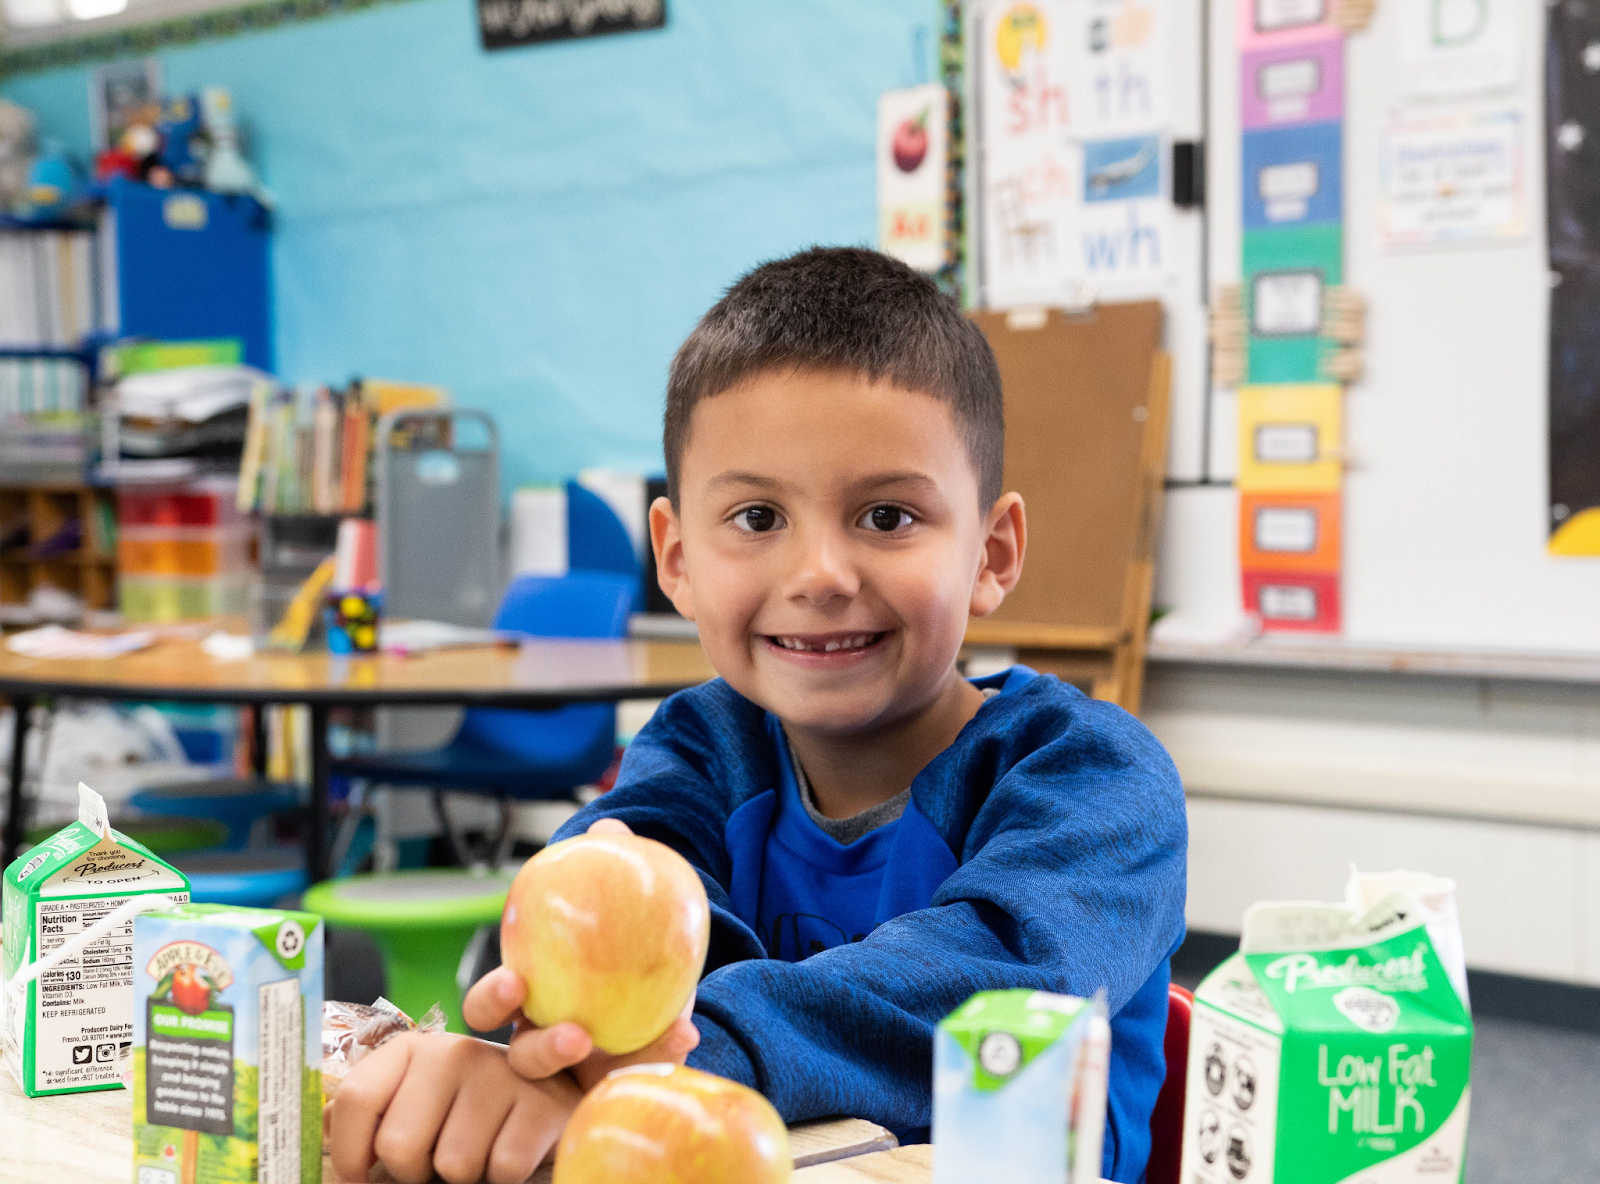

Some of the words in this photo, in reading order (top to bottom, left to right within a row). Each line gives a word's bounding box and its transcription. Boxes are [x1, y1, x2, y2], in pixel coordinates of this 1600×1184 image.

[1007, 65, 1070, 136] sh
[1094, 60, 1150, 118] th
[1081, 203, 1161, 271] wh
[74, 860, 145, 877] Producers
[41, 904, 59, 912] GRADE
[70, 901, 105, 910] PASTEURIZED
[42, 915, 76, 924] Nutrition
[42, 925, 64, 934] Facts
[156, 946, 191, 971] APPLE
[42, 970, 64, 978] Calories
[66, 971, 81, 981] 130
[42, 984, 85, 992] INGREDIENTS:
[42, 1010, 58, 1018] KEEP
[60, 1006, 106, 1017] REFRIGERATED
[153, 1013, 178, 1027] OUR
[180, 1015, 230, 1034] PROMISE
[55, 1067, 84, 1076] significant
[86, 1065, 113, 1074] difference
[1317, 1043, 1382, 1088] Low
[1388, 1043, 1438, 1088] Fat
[161, 1072, 181, 1084] and
[1327, 1083, 1426, 1134] MILK
